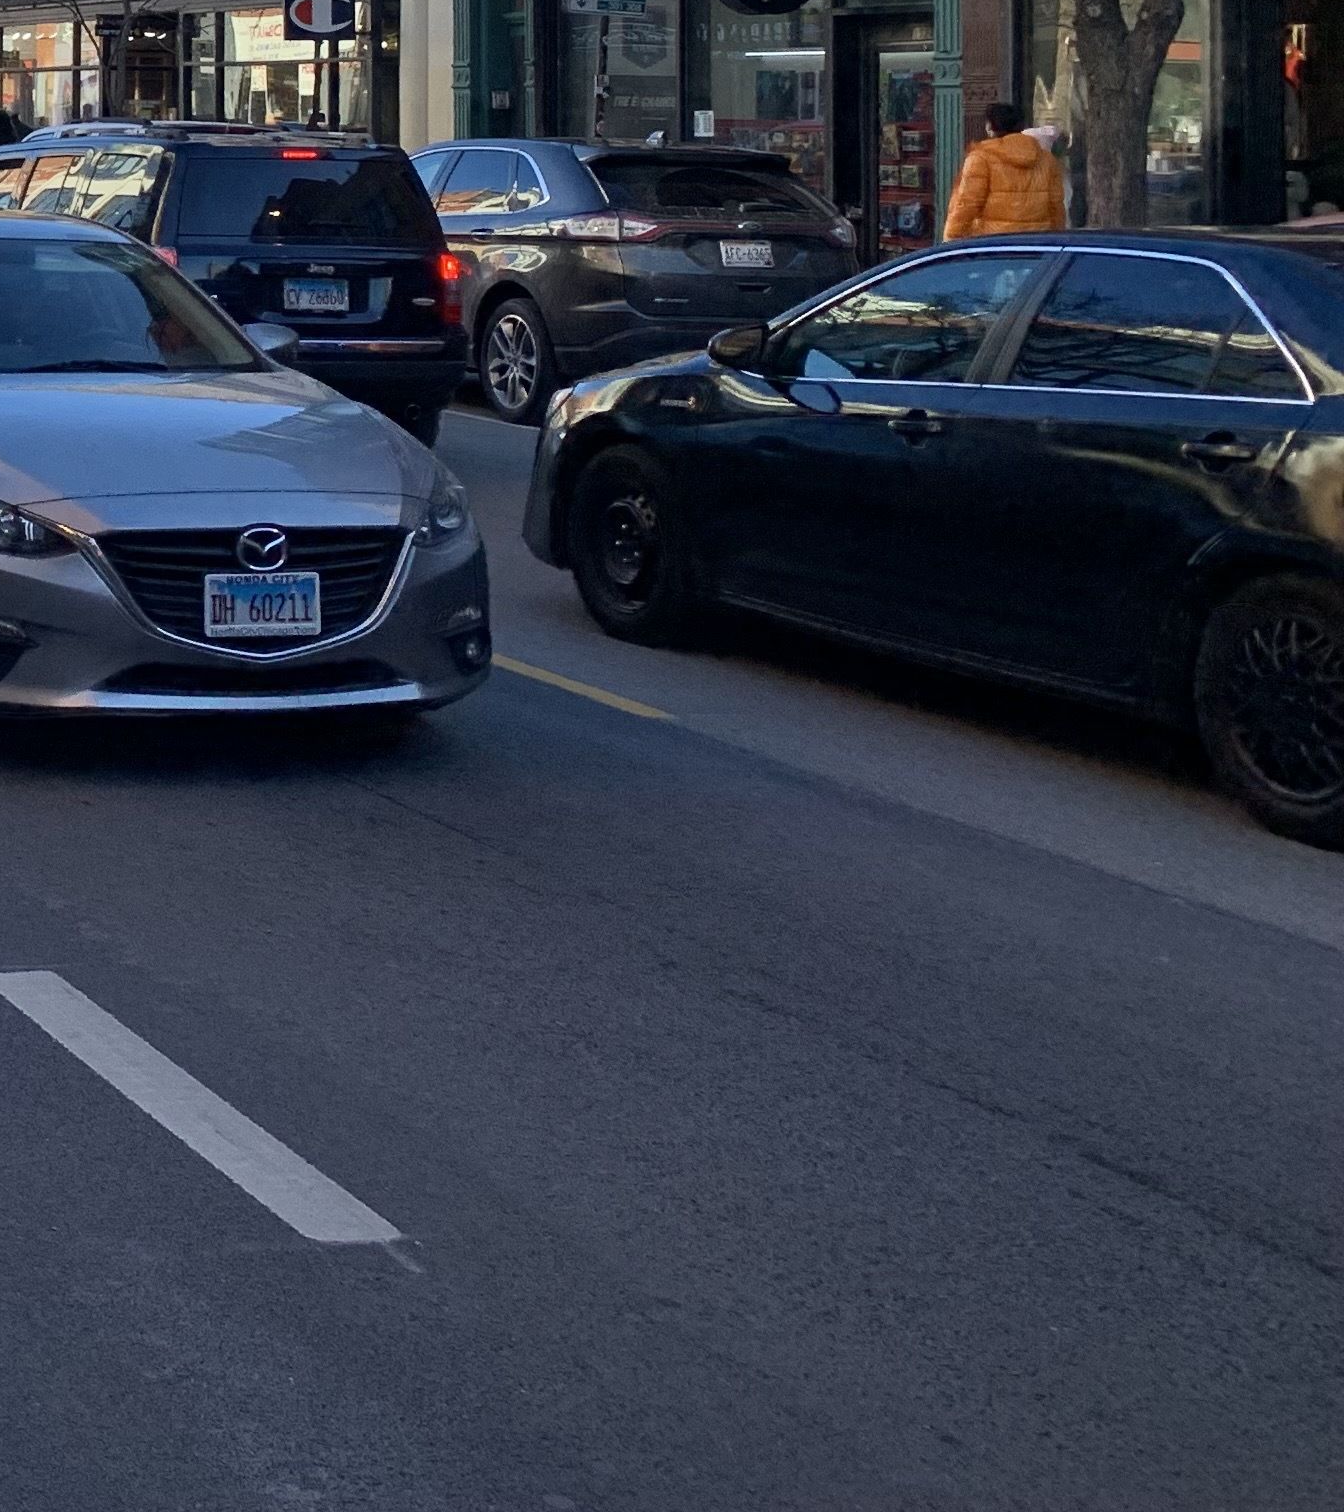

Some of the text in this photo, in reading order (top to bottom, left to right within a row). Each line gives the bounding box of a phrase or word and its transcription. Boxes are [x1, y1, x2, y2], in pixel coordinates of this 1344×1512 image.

[226, 574, 301, 585] HONDA CITY
[248, 592, 313, 623] 60211
